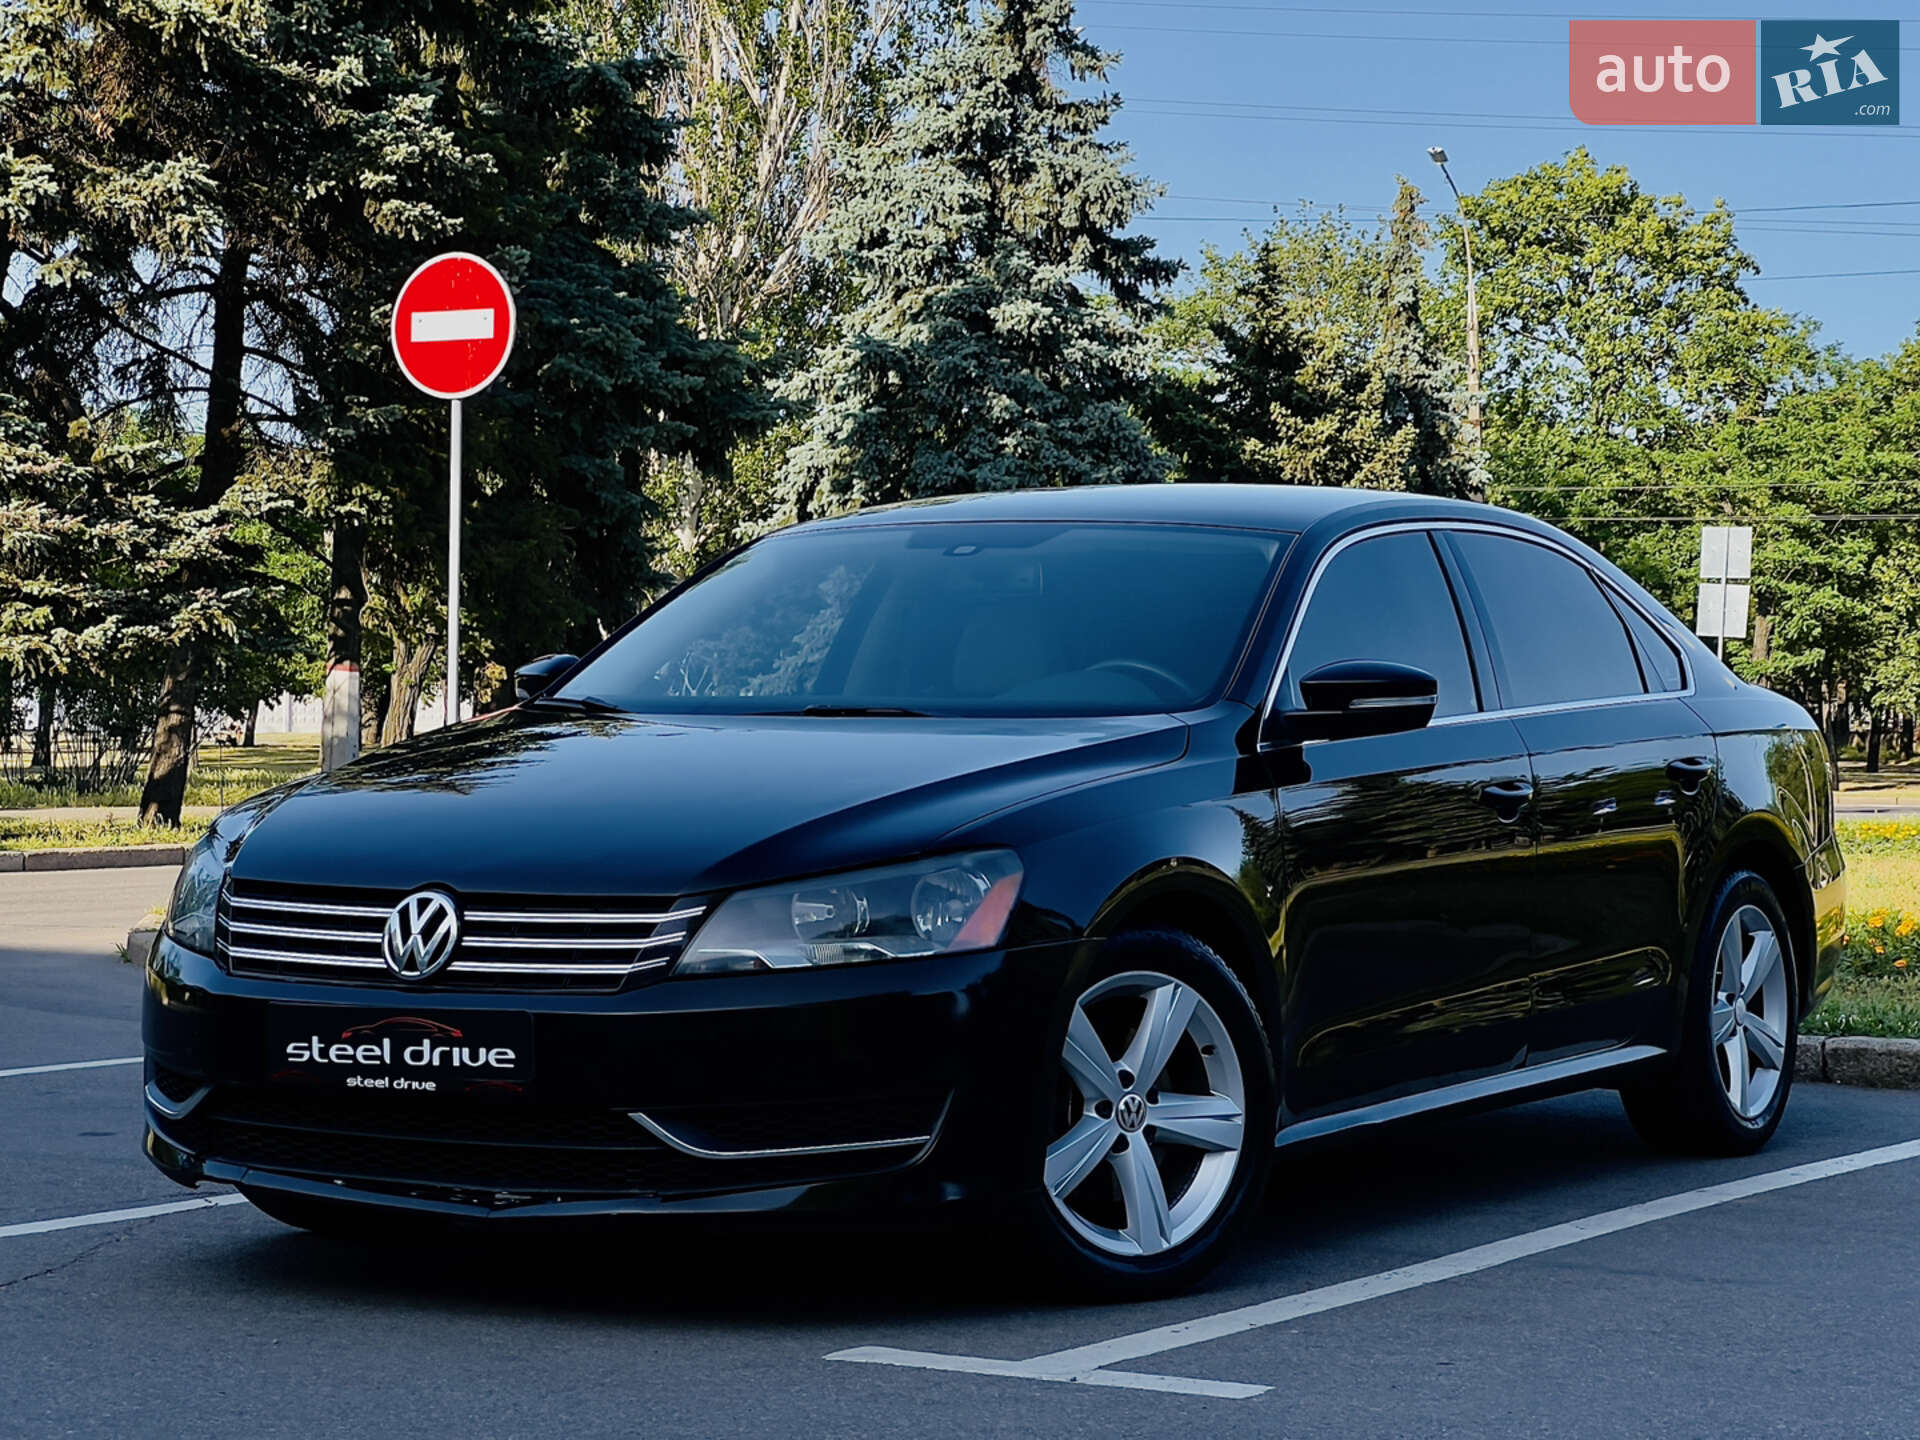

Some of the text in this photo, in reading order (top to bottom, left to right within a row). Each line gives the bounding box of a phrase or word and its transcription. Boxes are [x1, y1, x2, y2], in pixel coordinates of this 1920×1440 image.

[386, 893, 456, 976] VW
[286, 1035, 516, 1068] steel drive
[346, 1075, 437, 1091] steel drive
